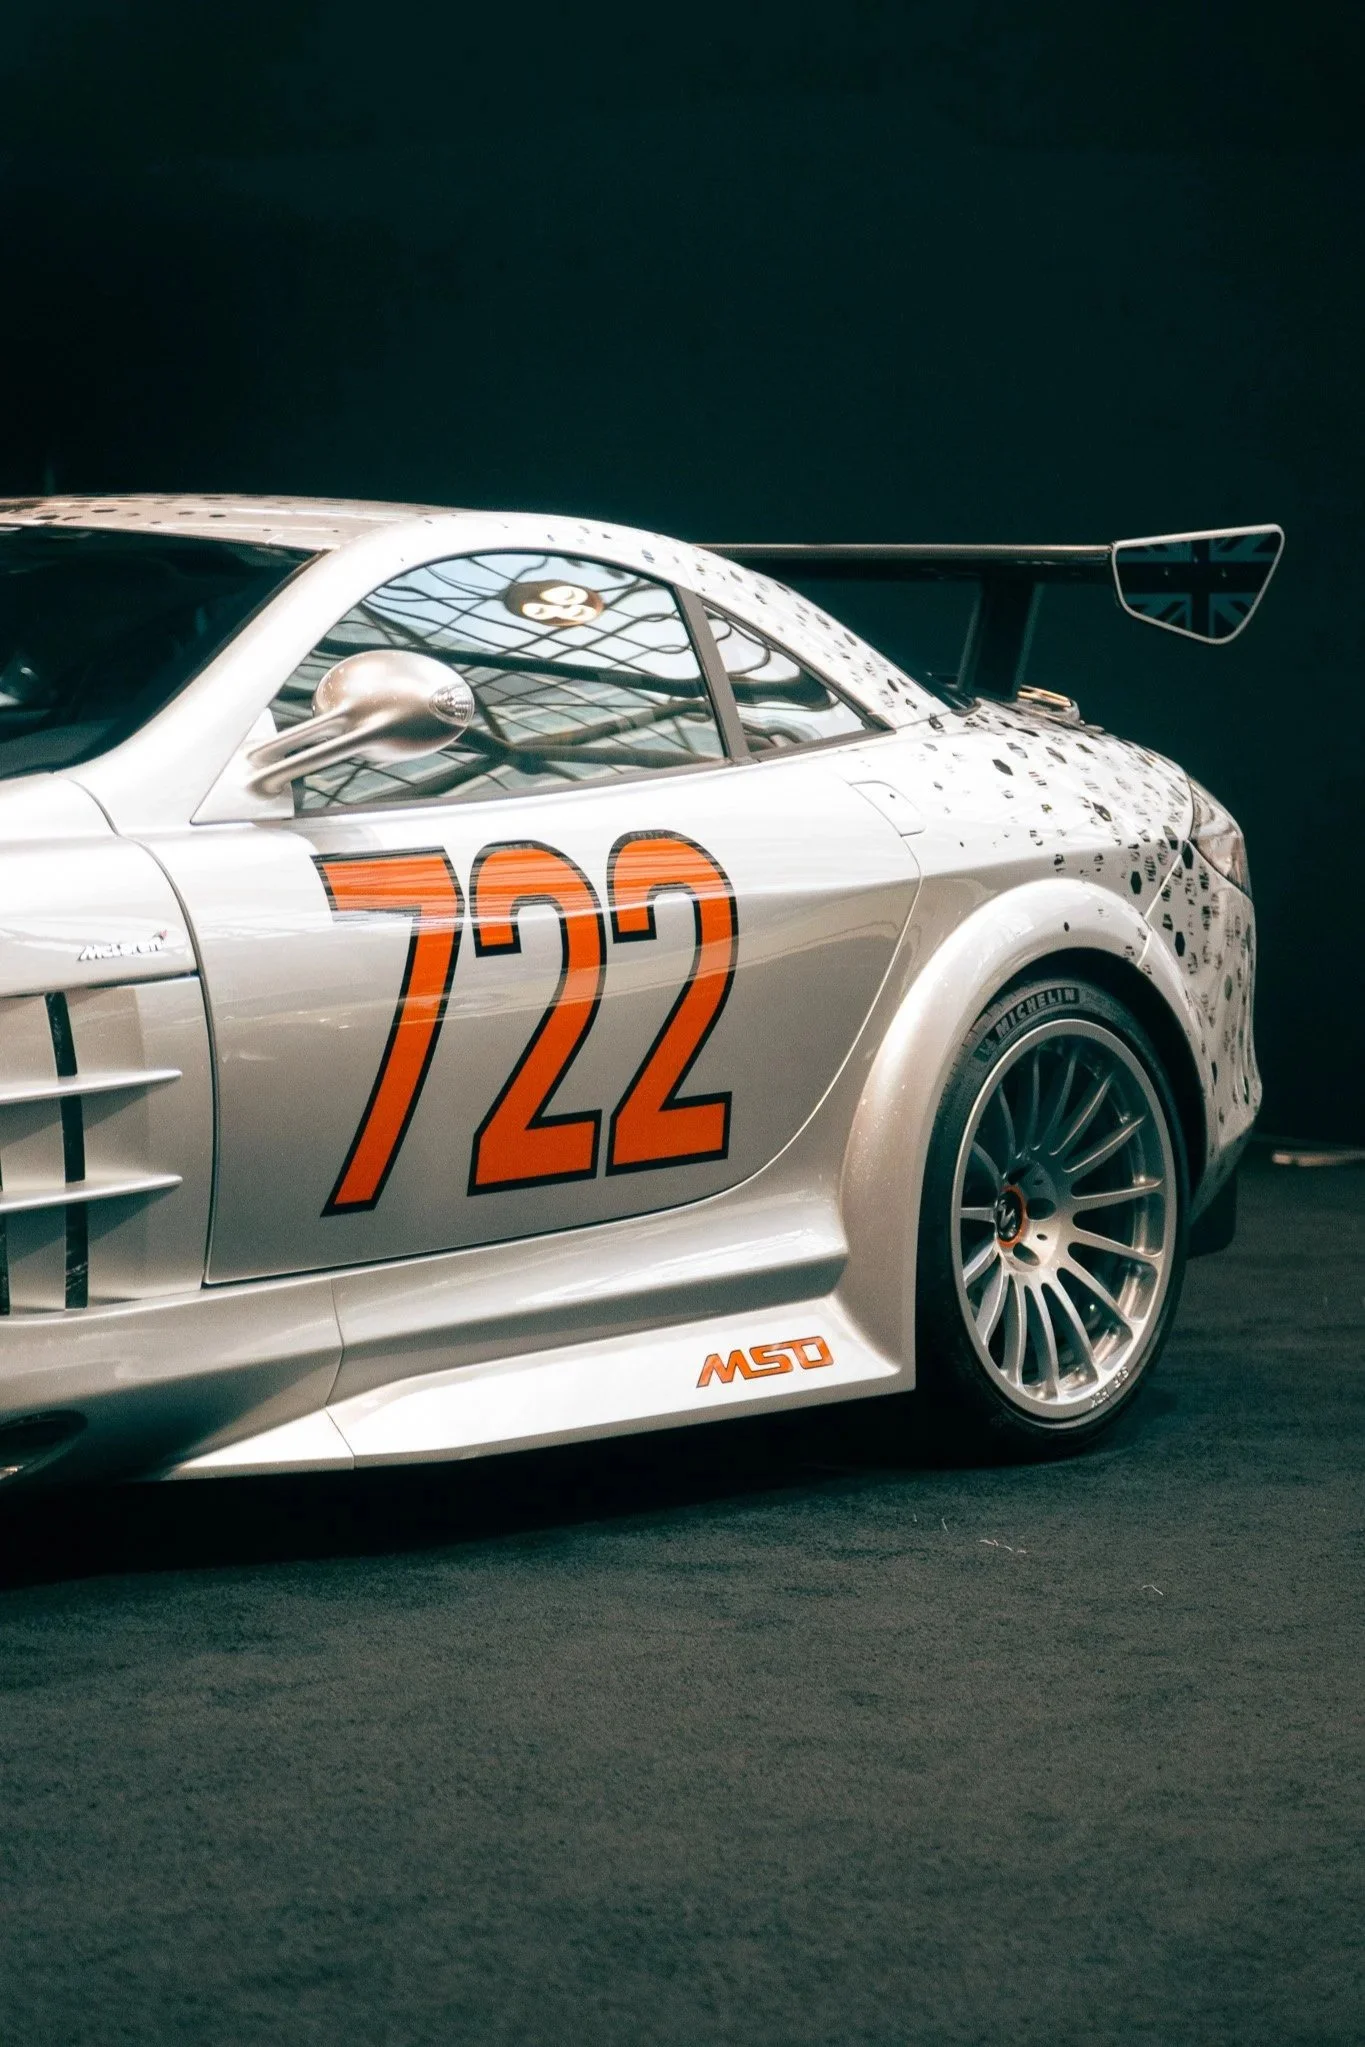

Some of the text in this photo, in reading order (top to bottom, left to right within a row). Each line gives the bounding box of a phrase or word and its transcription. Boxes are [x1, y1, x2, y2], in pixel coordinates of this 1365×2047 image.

[310, 829, 739, 1217] 722
[995, 987, 1077, 1038] MICHELIN
[696, 1335, 835, 1389] MSO
